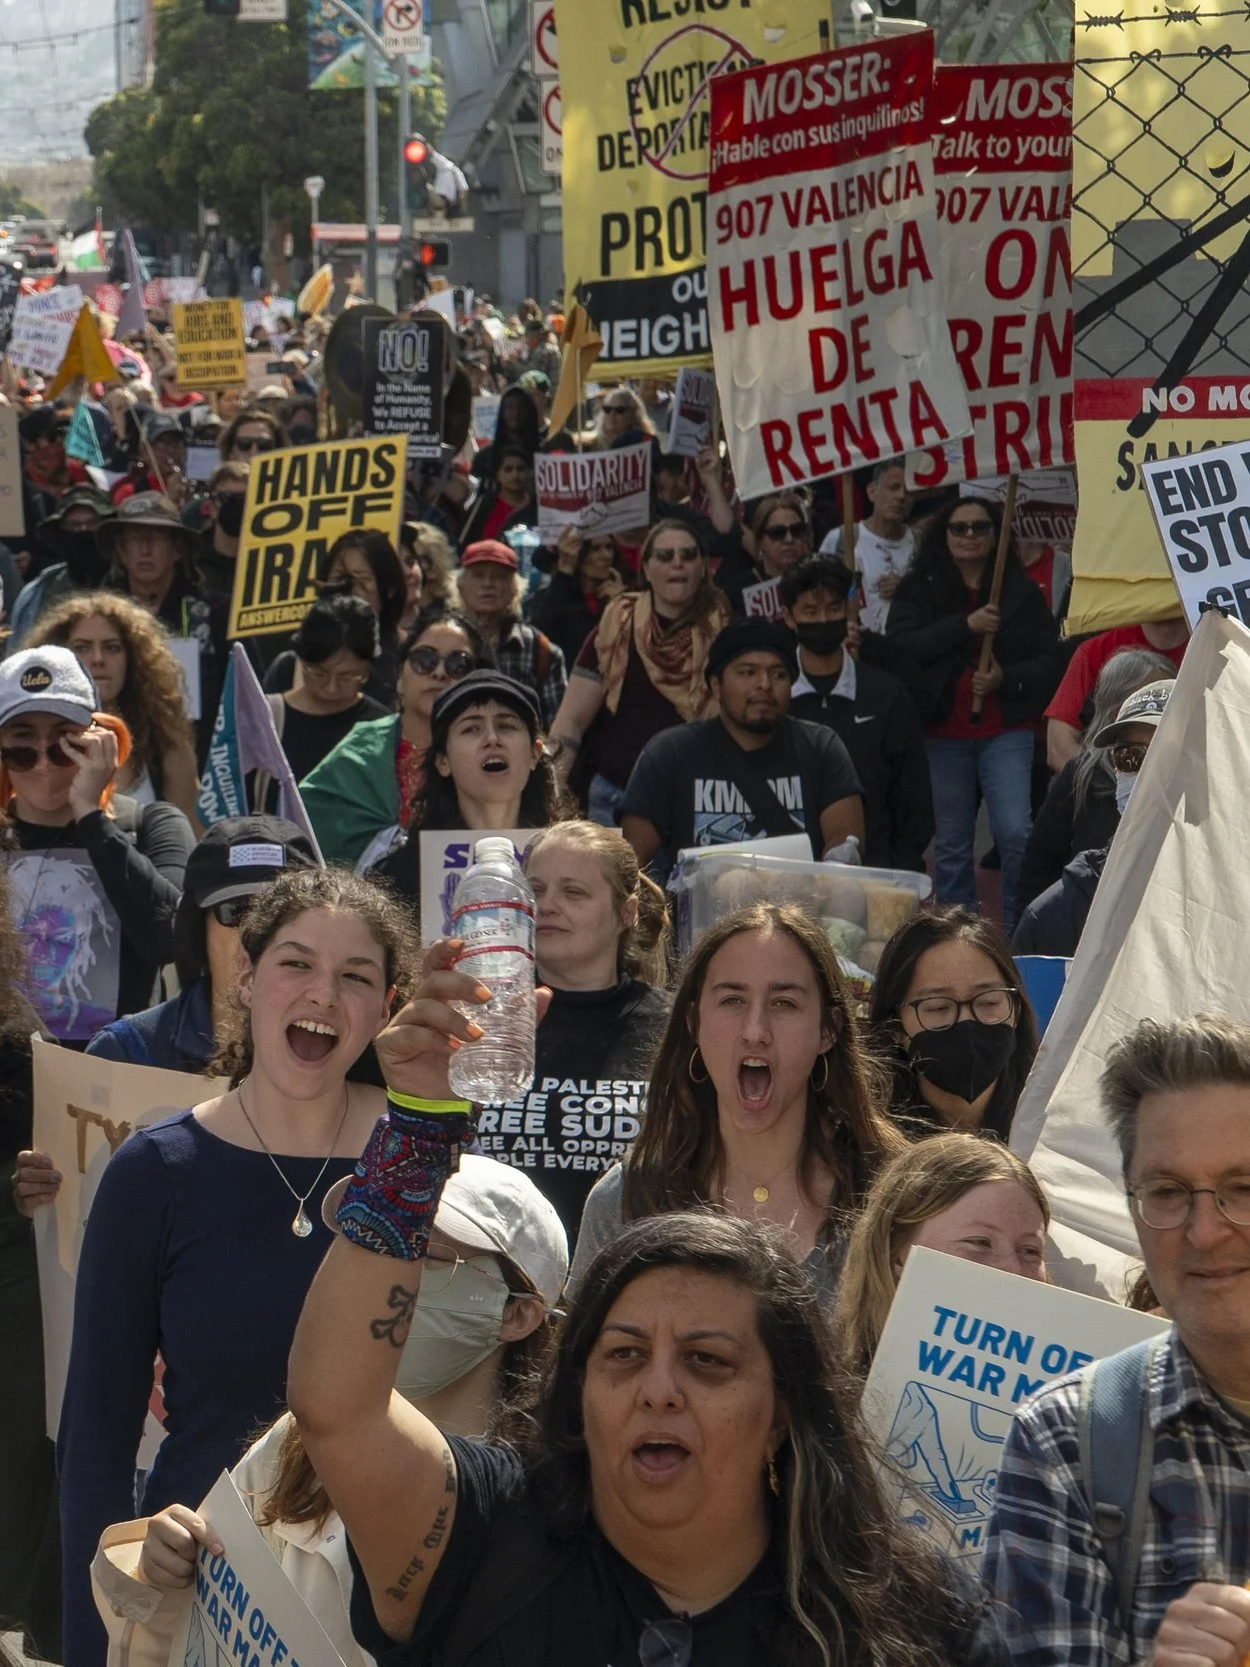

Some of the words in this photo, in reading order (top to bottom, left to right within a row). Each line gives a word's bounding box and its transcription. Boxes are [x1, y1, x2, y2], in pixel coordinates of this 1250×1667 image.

[743, 51, 891, 125] MOSSER:
[965, 76, 1072, 121] MOS
[597, 112, 710, 172] DEPORTA
[772, 126, 806, 151] con
[931, 131, 982, 159] Talk
[986, 133, 1011, 158] to
[1013, 134, 1072, 165] your
[716, 195, 774, 246] 907
[779, 159, 925, 230] VALENCIA
[601, 191, 707, 276] PROT
[672, 270, 708, 303] OU
[718, 219, 933, 333] HUELGA
[378, 329, 429, 373] NO!
[599, 308, 708, 358] EIGH
[808, 314, 876, 395] DE
[946, 308, 1074, 391] REN
[1142, 386, 1195, 413] NO
[760, 379, 948, 488] RENTA
[914, 392, 1075, 487] STRI
[256, 443, 397, 505] HANDS
[536, 449, 647, 492] SOLIDARITY
[1151, 459, 1237, 516] END
[251, 491, 395, 538] OFF
[1169, 506, 1250, 573] STO
[241, 539, 328, 607] IRA
[694, 775, 803, 813] KMM
[541, 1077, 650, 1095] PALESTI
[560, 1096, 648, 1114] CON
[477, 1111, 546, 1134] REE
[561, 1115, 641, 1139] SUD
[480, 1136, 504, 1150] EE
[512, 1137, 555, 1151] ALL
[544, 1154, 620, 1171] EVERY
[933, 1305, 1035, 1365] TURN
[1040, 1344, 1098, 1375] OF
[918, 1341, 1006, 1398] WAR
[200, 1549, 250, 1621] TURN
[248, 1607, 289, 1667] OFF
